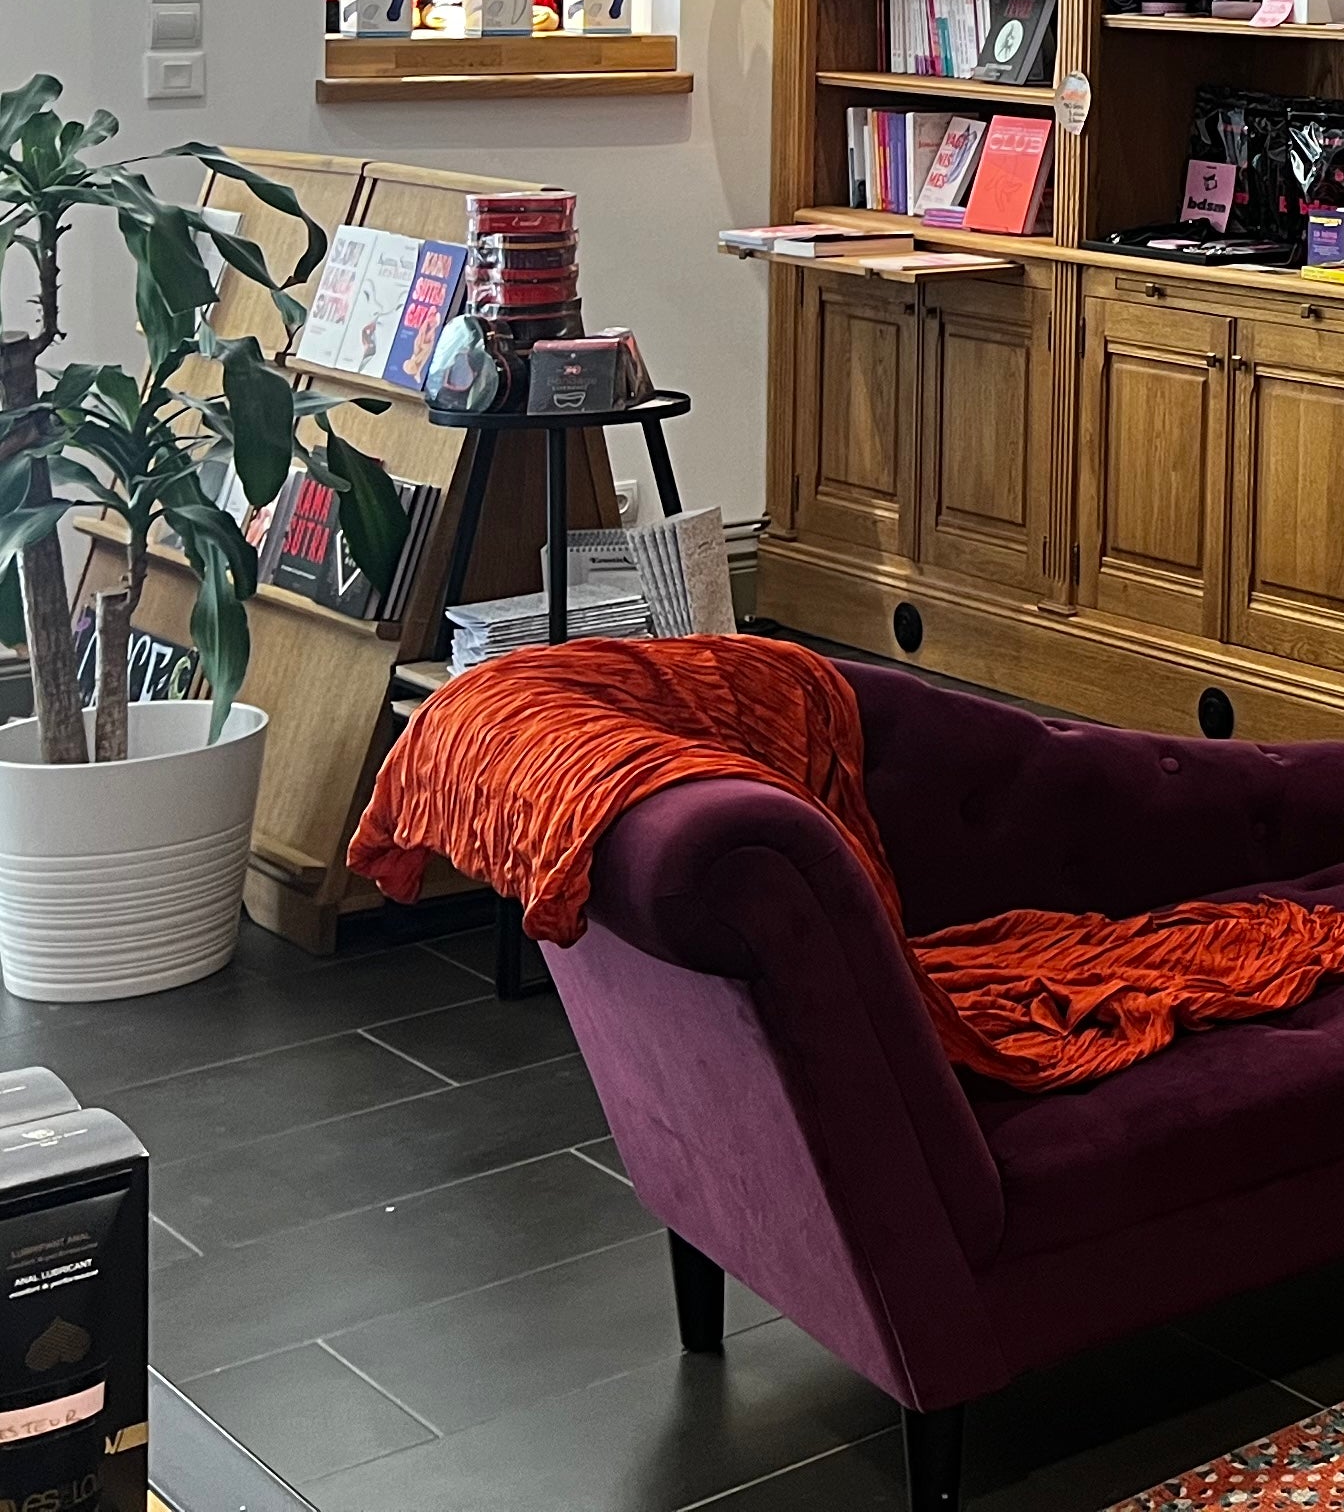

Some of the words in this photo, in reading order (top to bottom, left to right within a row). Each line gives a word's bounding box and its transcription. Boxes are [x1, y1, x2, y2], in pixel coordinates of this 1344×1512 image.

[989, 133, 1044, 154] CLUB
[1187, 197, 1226, 214] bdsm
[14, 1273, 40, 1287] ANAL
[41, 1258, 93, 1280] LUBRICANT
